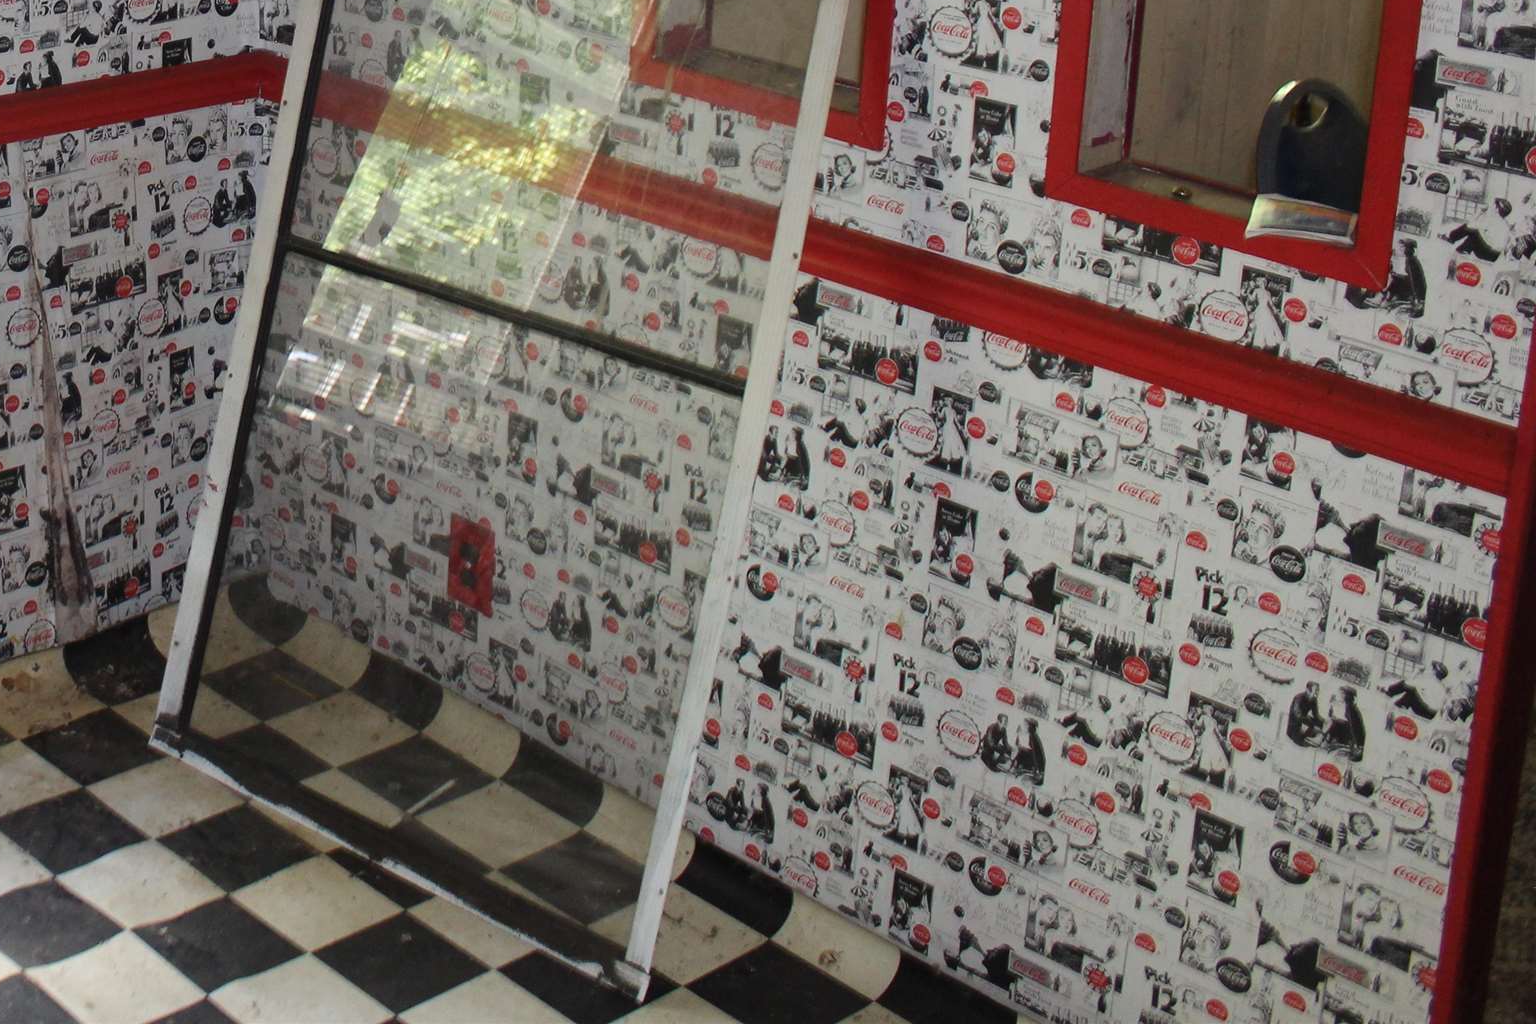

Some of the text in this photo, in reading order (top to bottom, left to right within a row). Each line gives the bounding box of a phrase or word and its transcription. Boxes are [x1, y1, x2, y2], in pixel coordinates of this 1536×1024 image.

[147, 180, 165, 197] Pick
[154, 191, 170, 213] 12
[1201, 307, 1246, 327] Coca-Cola
[1444, 345, 1491, 368] Coca-Cola
[1117, 483, 1161, 505] Coca-Cola
[1196, 567, 1223, 584] Pick
[1202, 585, 1228, 616] 12
[893, 654, 915, 669] Pick
[1253, 640, 1296, 667] Coca-Cola
[899, 671, 920, 697] 12
[1150, 725, 1193, 748] Coca-Cola
[1382, 792, 1427, 817] Coca-Cola
[1068, 879, 1110, 905] Coca-Cola
[1392, 865, 1446, 896] Coca-Cola
[1145, 966, 1171, 985] Pick
[1152, 985, 1177, 1015] 12
